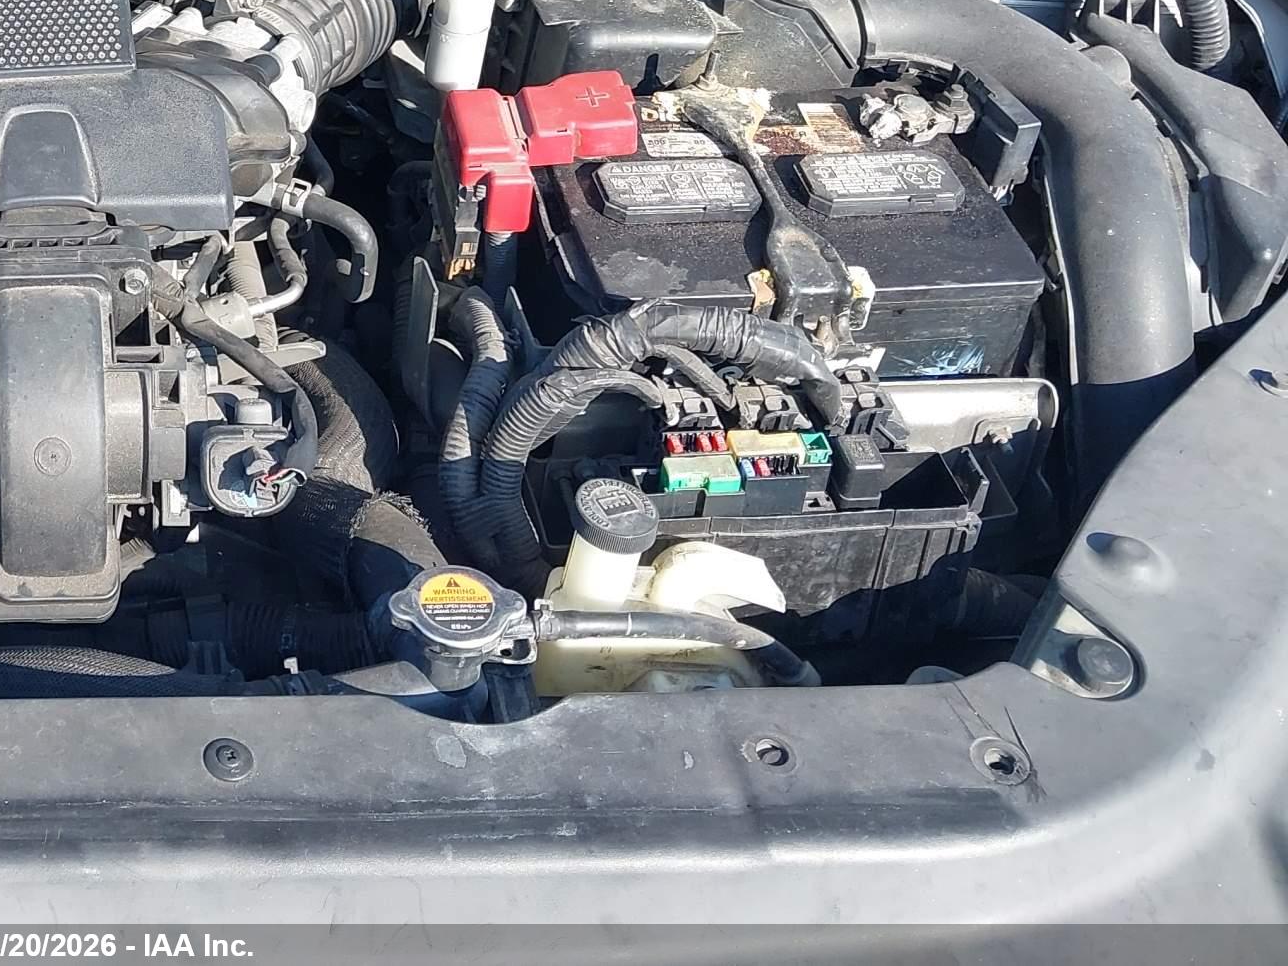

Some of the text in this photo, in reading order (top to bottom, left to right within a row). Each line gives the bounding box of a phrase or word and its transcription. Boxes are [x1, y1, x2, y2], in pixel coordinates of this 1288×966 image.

[622, 164, 671, 174] DANGER
[682, 162, 727, 172] POISON
[432, 588, 476, 596] WARNING
[424, 595, 487, 603] AVERTISSEMENT
